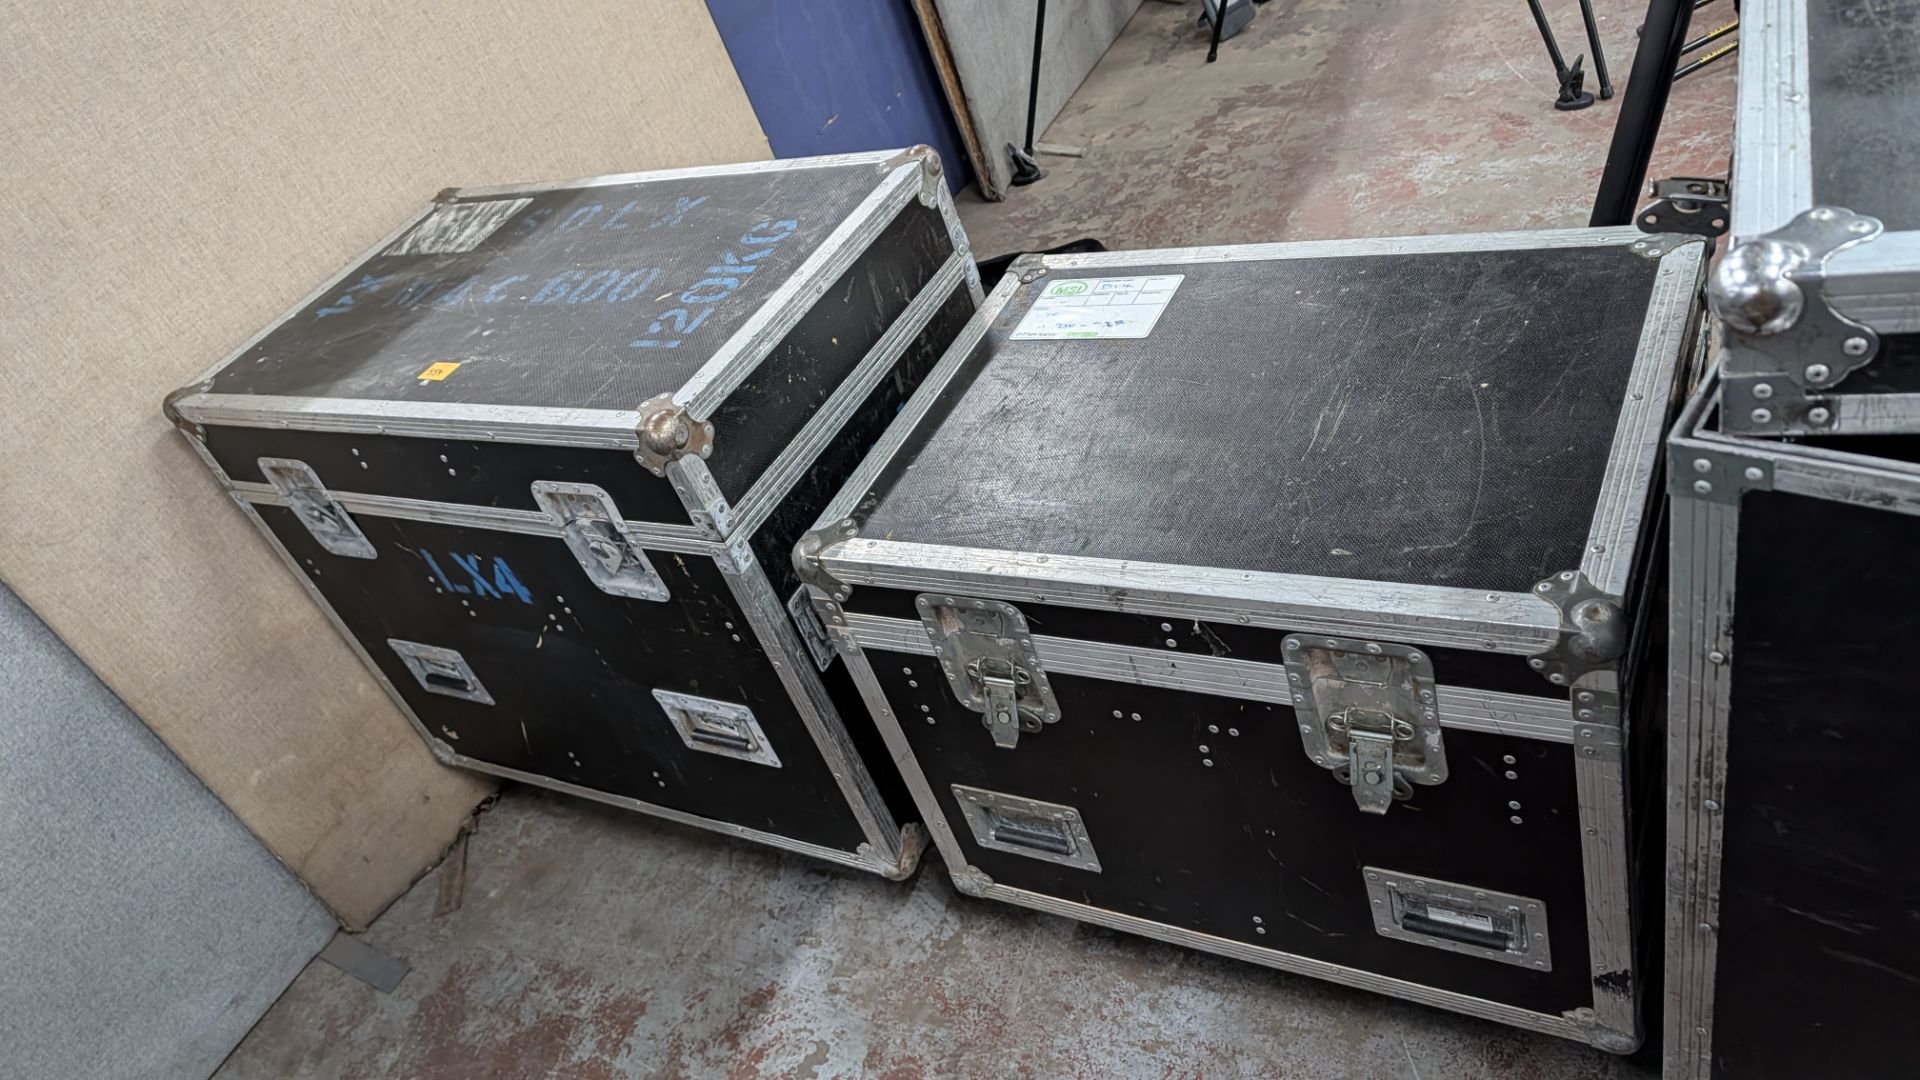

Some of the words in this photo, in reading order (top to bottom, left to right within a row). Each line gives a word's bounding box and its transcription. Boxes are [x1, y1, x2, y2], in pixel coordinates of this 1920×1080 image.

[528, 266, 662, 304] 600
[629, 219, 799, 348] 120KG
[420, 548, 533, 605] LX4
